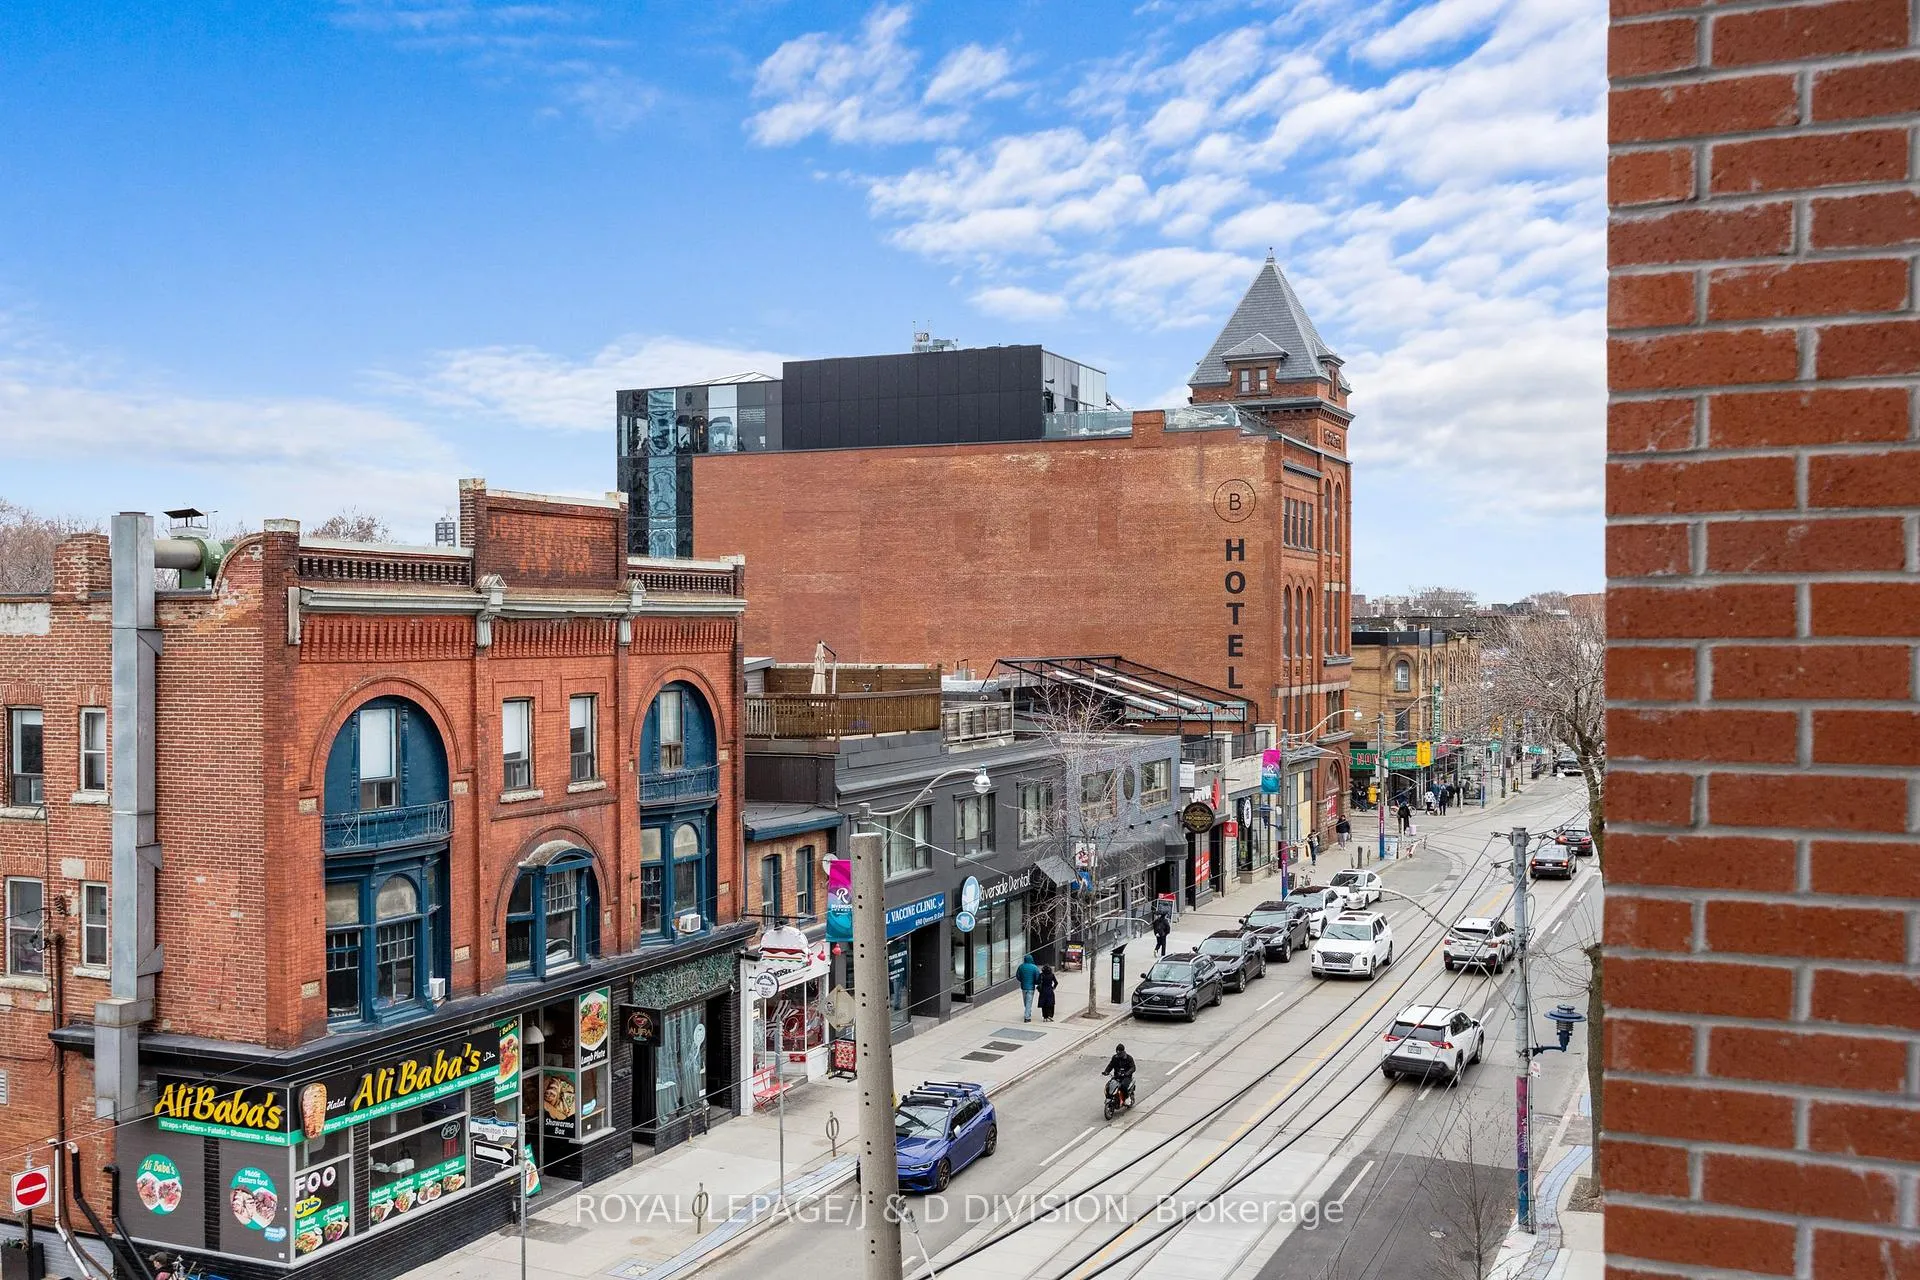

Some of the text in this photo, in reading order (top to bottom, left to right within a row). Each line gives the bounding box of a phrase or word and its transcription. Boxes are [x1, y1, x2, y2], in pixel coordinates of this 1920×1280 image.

[1229, 493, 1241, 510] B
[1225, 538, 1246, 690] HOTEL
[1009, 869, 1031, 892] Dental
[836, 887, 848, 903] R
[891, 904, 915, 922] VACCINE
[916, 898, 937, 914] CLINIC
[628, 1026, 652, 1037] AURA
[593, 1049, 606, 1061] Plate
[353, 1043, 481, 1112] Ali Baba's
[154, 1083, 281, 1130] Ali Baba's
[326, 1097, 346, 1111] Halal
[545, 1118, 574, 1128] Shawarma
[554, 1127, 565, 1135] Box
[297, 1200, 320, 1214] حلال
